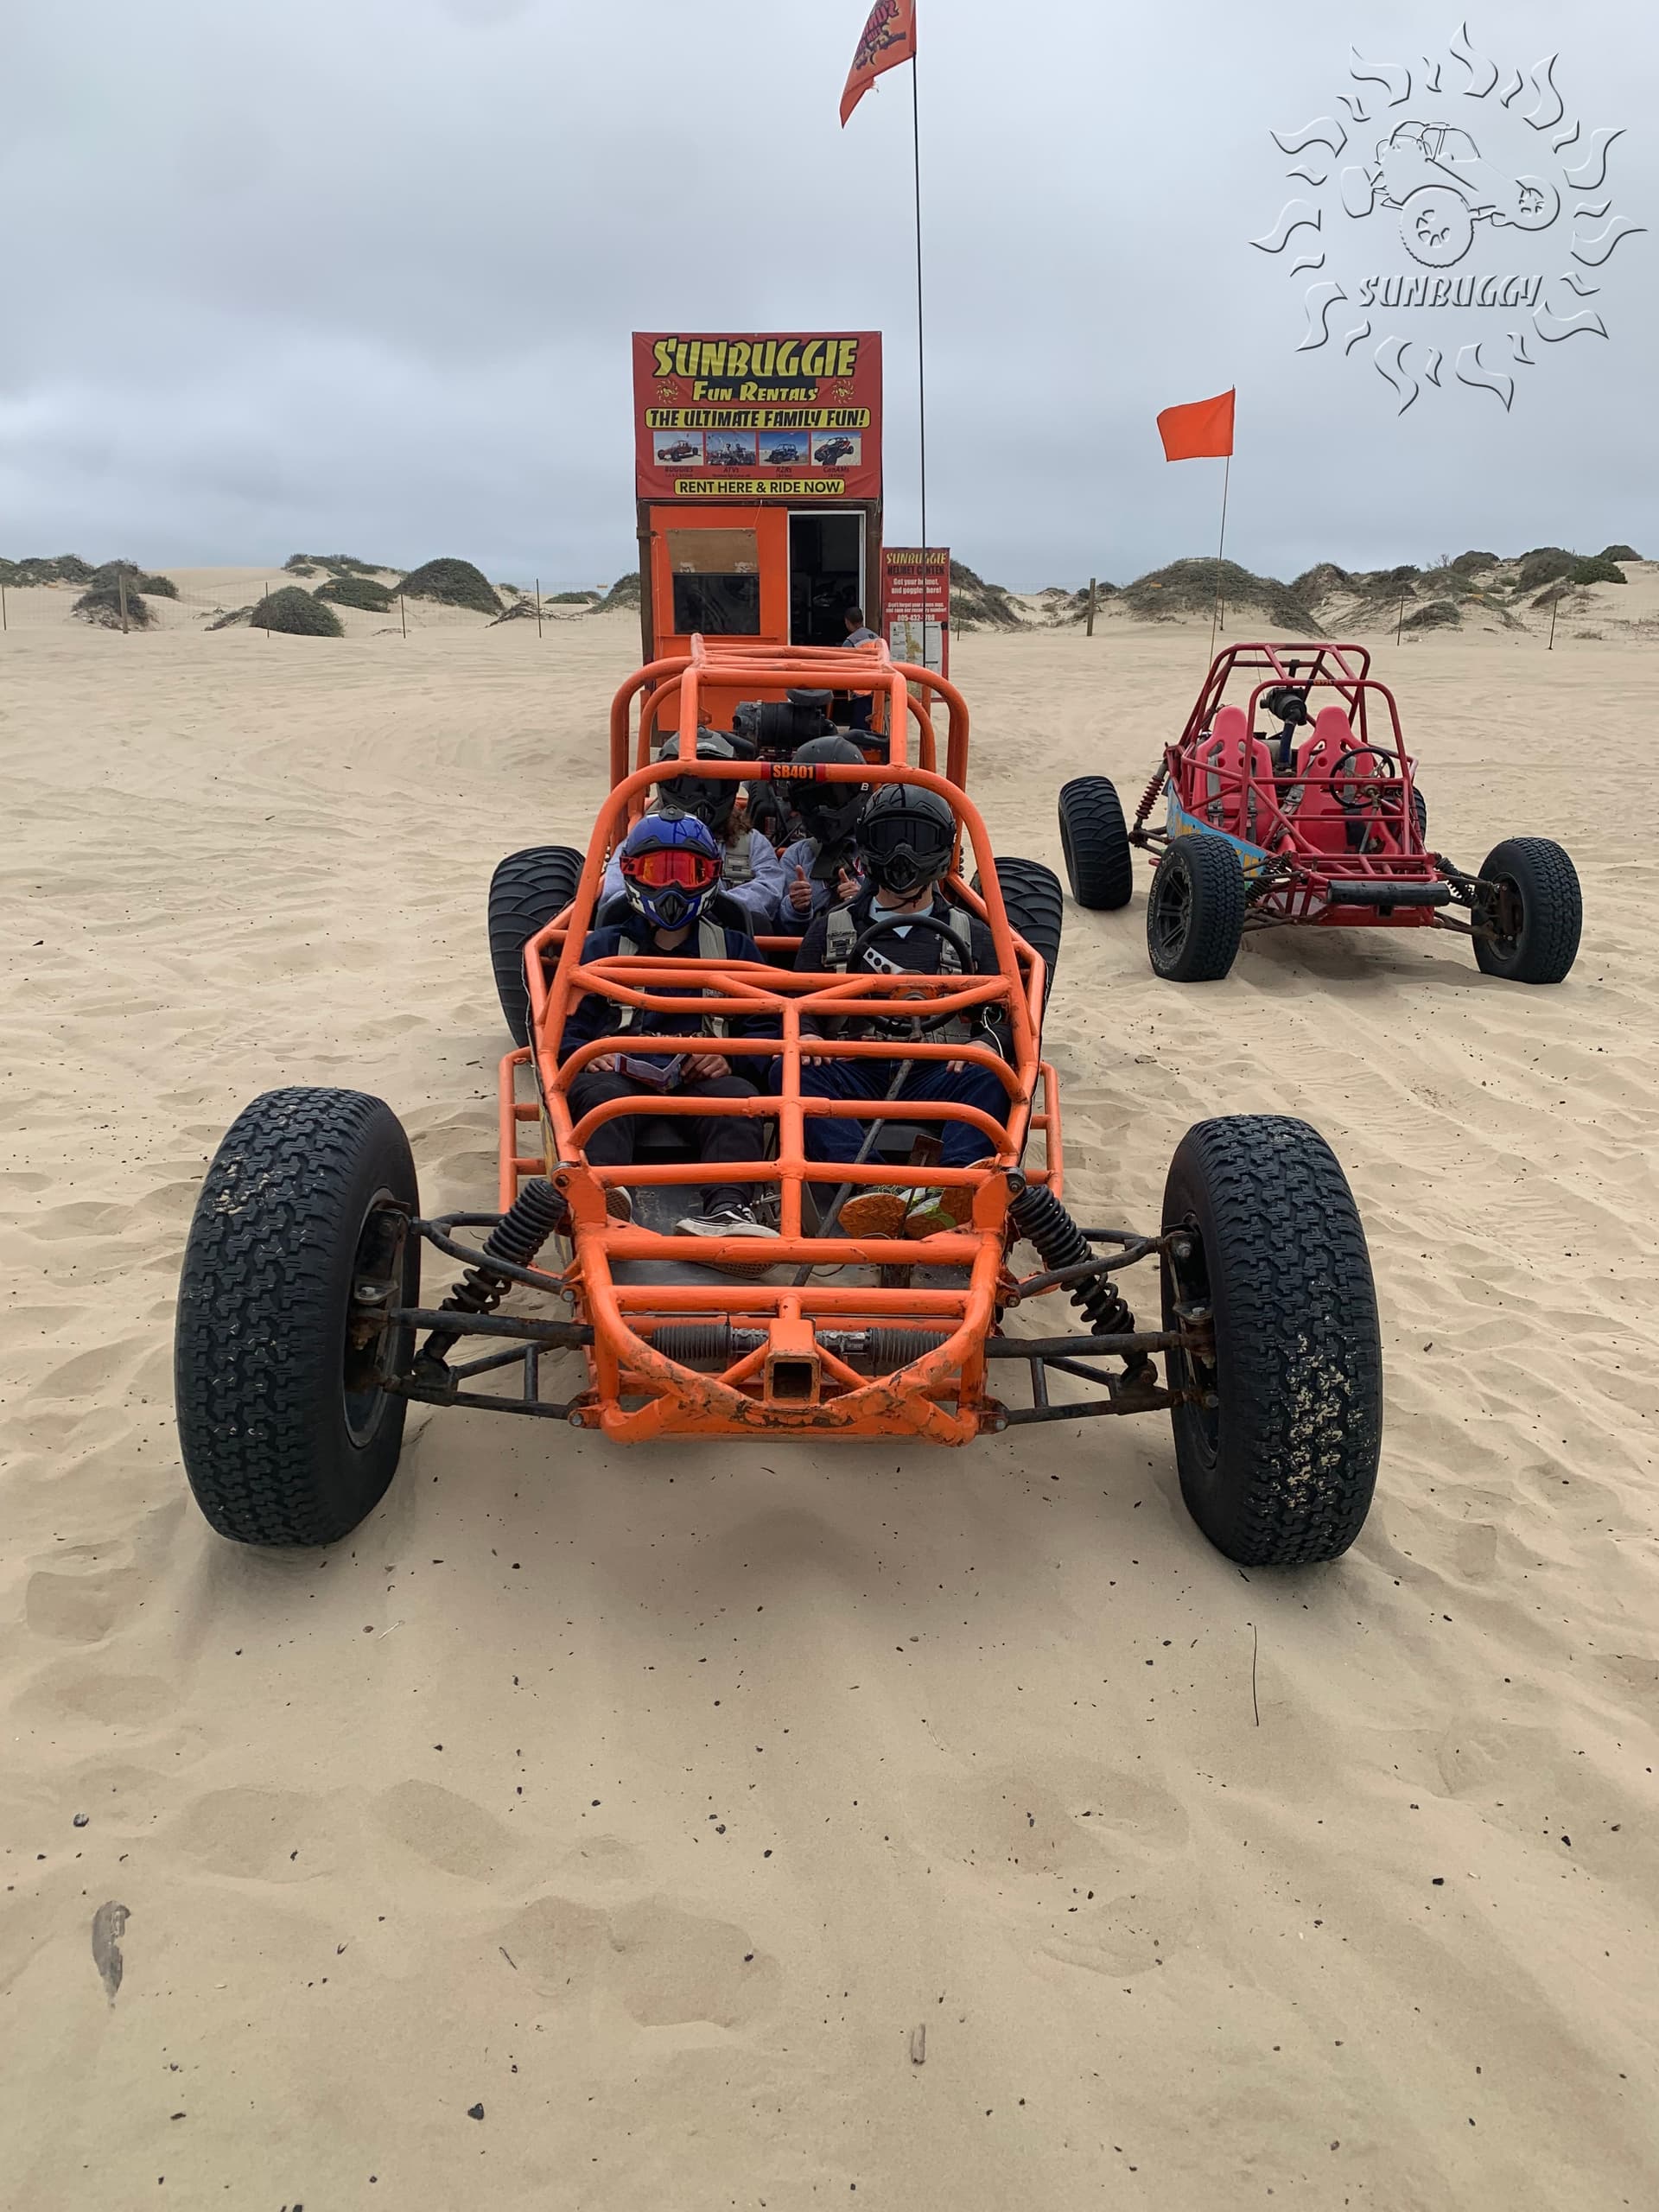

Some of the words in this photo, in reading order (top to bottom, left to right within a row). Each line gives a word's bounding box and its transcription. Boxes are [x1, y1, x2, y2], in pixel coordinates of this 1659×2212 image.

[652, 338, 858, 377] SUNBUGGIE
[651, 410, 679, 426] THE
[683, 410, 759, 427] ULTIMATE
[765, 410, 820, 427] FAMILY
[826, 410, 866, 426] FUN!
[680, 481, 715, 493] RENT
[718, 481, 752, 493] HERE
[756, 481, 766, 493] &
[770, 481, 800, 493] RIDE
[804, 481, 840, 493] NOW
[918, 566, 944, 575] CNTER
[773, 765, 814, 779] SB401
